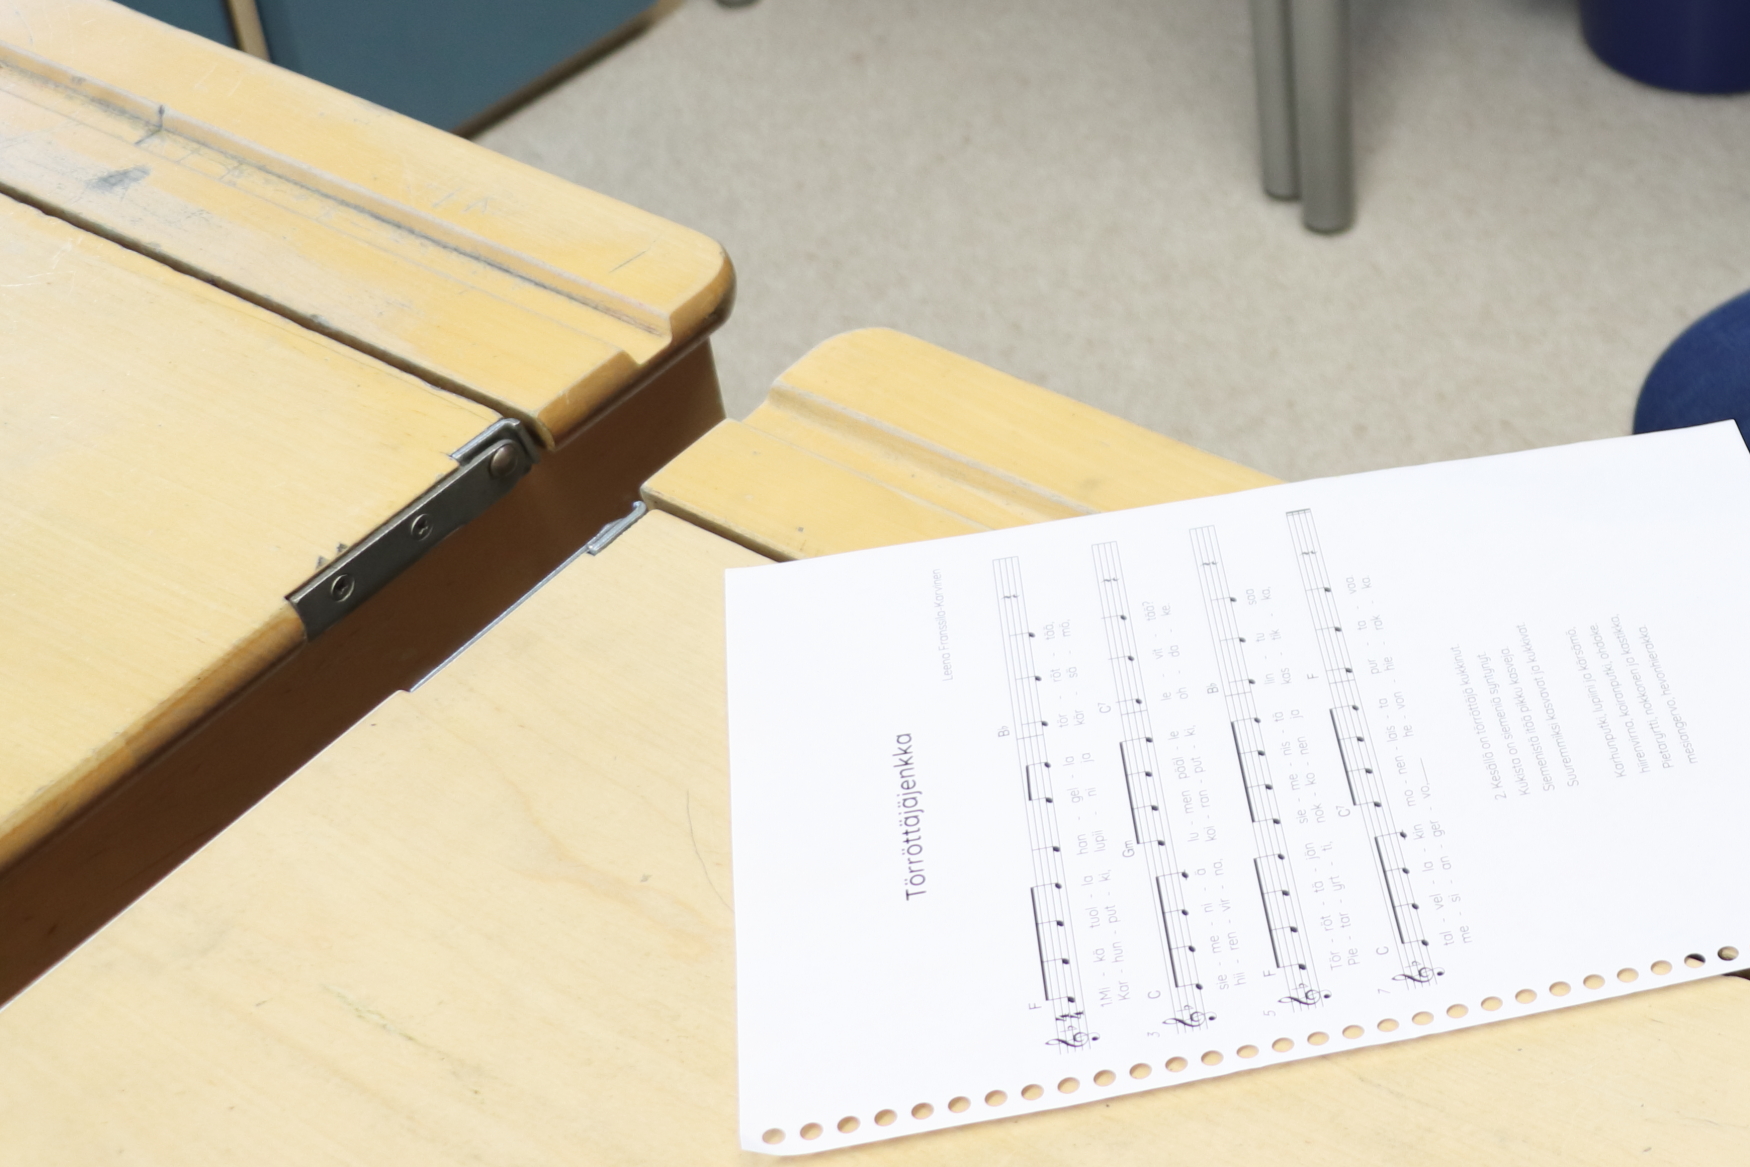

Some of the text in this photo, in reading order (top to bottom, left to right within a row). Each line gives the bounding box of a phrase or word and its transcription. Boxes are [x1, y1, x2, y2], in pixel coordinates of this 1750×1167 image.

[1245, 588, 1257, 606] saa
[932, 569, 953, 681] Leena Franssila-Karvinen
[1357, 620, 1368, 631] ta
[1370, 614, 1384, 631] rak
[1255, 632, 1266, 643] tu
[1269, 628, 1281, 641] tik
[1152, 648, 1164, 660] vit
[1168, 644, 1180, 658] da
[1367, 659, 1383, 675] pur
[1383, 656, 1395, 672] hie
[1625, 656, 1640, 667] ja
[1280, 667, 1292, 685] kas
[1531, 665, 1545, 675] ja
[1583, 672, 1597, 683] ja
[1264, 673, 1275, 685] lin
[1160, 692, 1172, 701] le
[1176, 687, 1189, 700] oh
[1513, 687, 1532, 713] pikku
[1533, 676, 1557, 721] kasvavat
[1585, 684, 1604, 713] lupiini
[1630, 668, 1655, 716] nokkonen
[1378, 697, 1389, 709] ta
[1393, 691, 1406, 710] von
[1289, 709, 1304, 719] ja
[1168, 730, 1180, 741] le
[1385, 725, 1398, 743] lais
[1402, 724, 1414, 738] he
[1280, 741, 1292, 756] nis
[1297, 736, 1309, 756] nen
[1479, 736, 1491, 750] on
[1506, 741, 1518, 755] on
[1062, 756, 1075, 767] la
[1080, 752, 1095, 764] ja
[1548, 722, 1580, 787] Suuremmiksi
[1190, 756, 1206, 774] put
[1394, 755, 1408, 775] nen
[1288, 773, 1301, 791] me
[1304, 772, 1317, 787] ko
[1511, 757, 1531, 796] Kukista
[1066, 787, 1084, 804] gel
[1085, 787, 1097, 797] ni
[1198, 789, 1210, 808] ran
[1404, 789, 1416, 807] mo
[1181, 790, 1194, 814] men
[891, 732, 927, 902] Törröttäjäjenkka
[1296, 809, 1309, 824] sie
[1310, 802, 1326, 824] nok
[1187, 832, 1199, 842] lu
[1203, 825, 1217, 842] koi
[1412, 823, 1425, 841] kin
[1429, 820, 1446, 838] ger
[1076, 833, 1089, 856] han
[1091, 830, 1108, 853] lupii
[1121, 839, 1136, 858] Gm
[1422, 861, 1434, 873] la
[1440, 855, 1452, 871] an
[1081, 875, 1094, 887] la
[1328, 875, 1346, 892] yrt
[1218, 898, 1231, 912] vir
[1428, 893, 1444, 911] vel
[1448, 893, 1461, 903] si
[1104, 904, 1121, 924] put
[1200, 902, 1214, 913] ni
[1085, 906, 1101, 929] tuol
[1338, 912, 1351, 929] tar
[1227, 931, 1239, 951] ren
[1438, 930, 1455, 946] tal
[1459, 925, 1473, 944] me
[1111, 941, 1124, 963] hun
[1209, 935, 1222, 954] me
[1375, 946, 1390, 956] C
[1347, 947, 1360, 966] Pie
[1233, 972, 1247, 986] hii
[1262, 969, 1276, 978] F
[1216, 974, 1230, 990] sie
[1117, 980, 1131, 1001] Kar
[1147, 989, 1161, 1000] C
[1028, 1002, 1042, 1011] F
